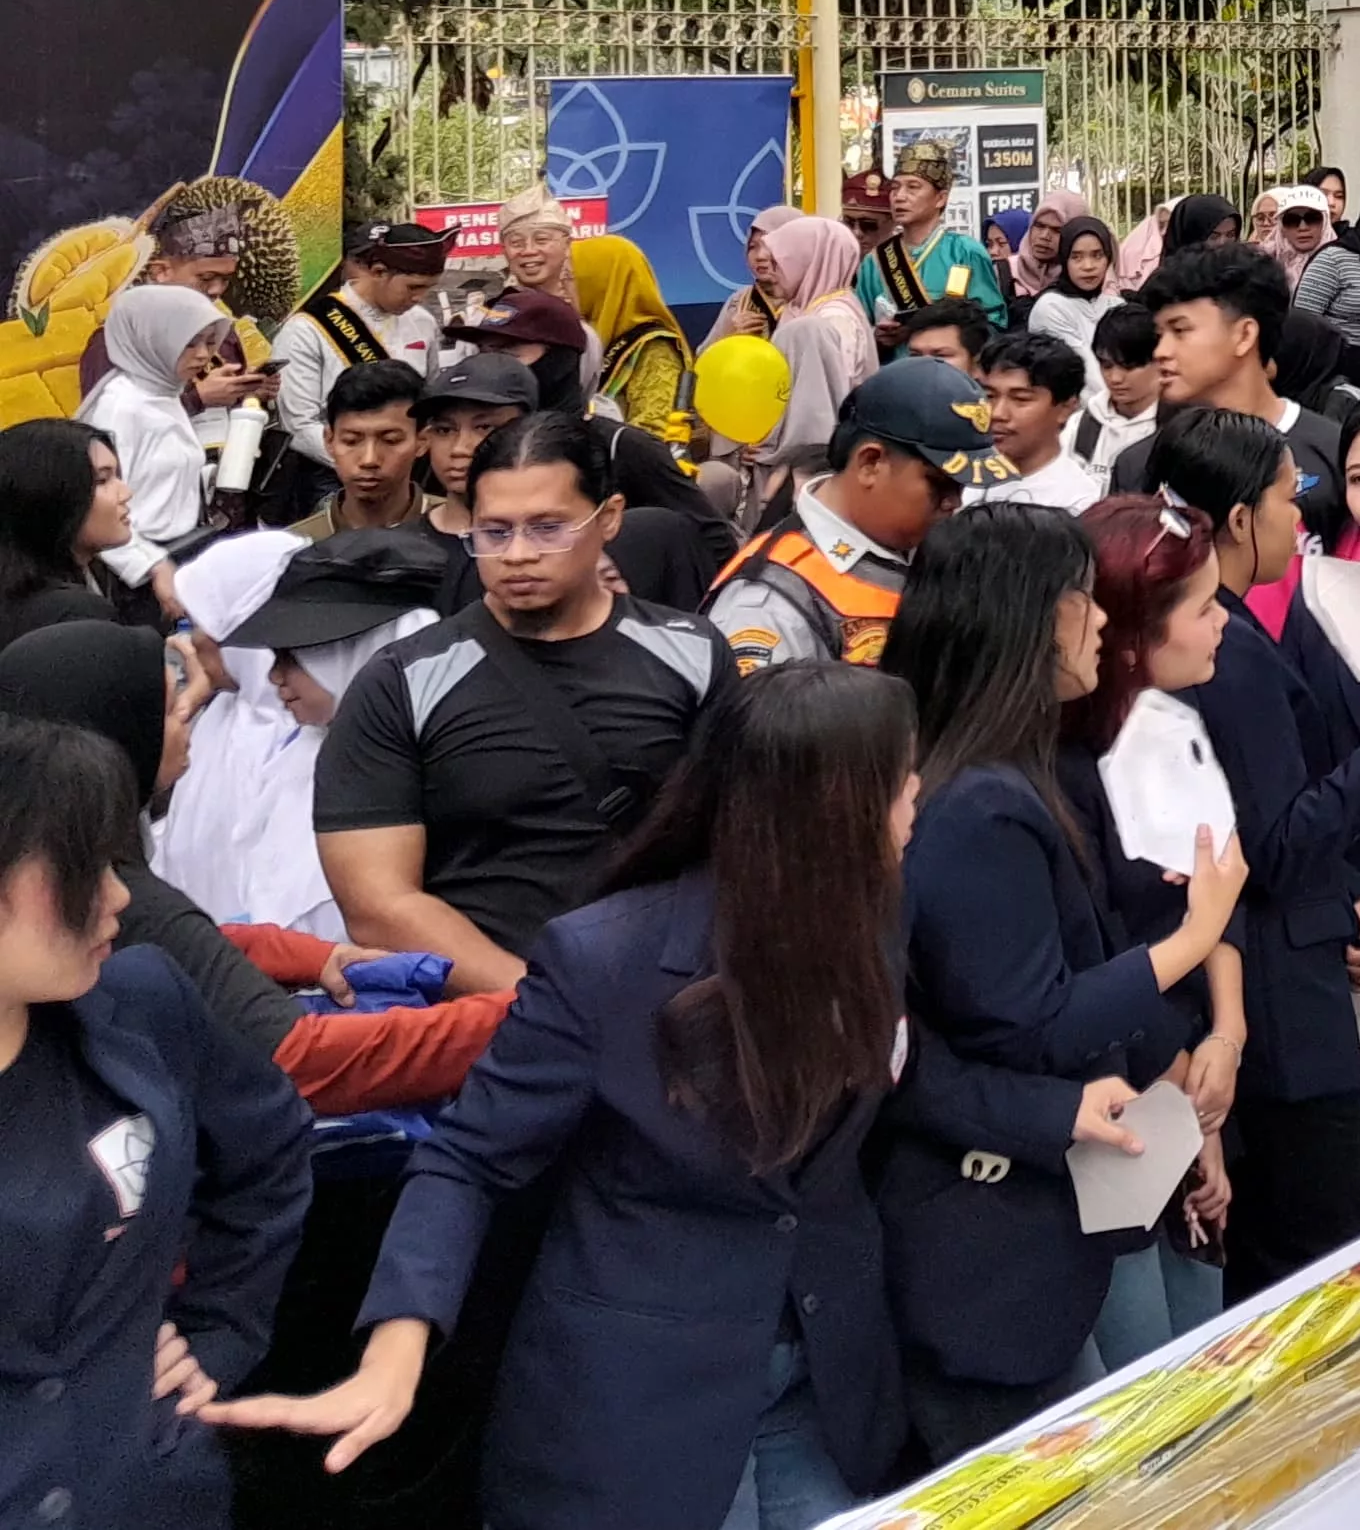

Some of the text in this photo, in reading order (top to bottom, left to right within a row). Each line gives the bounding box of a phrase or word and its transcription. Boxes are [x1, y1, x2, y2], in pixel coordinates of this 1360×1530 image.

[927, 81, 1026, 99] Cemara Suites
[983, 150, 1033, 169] 1.350M
[987, 192, 1033, 215] FREE
[326, 308, 360, 343] TANDA
